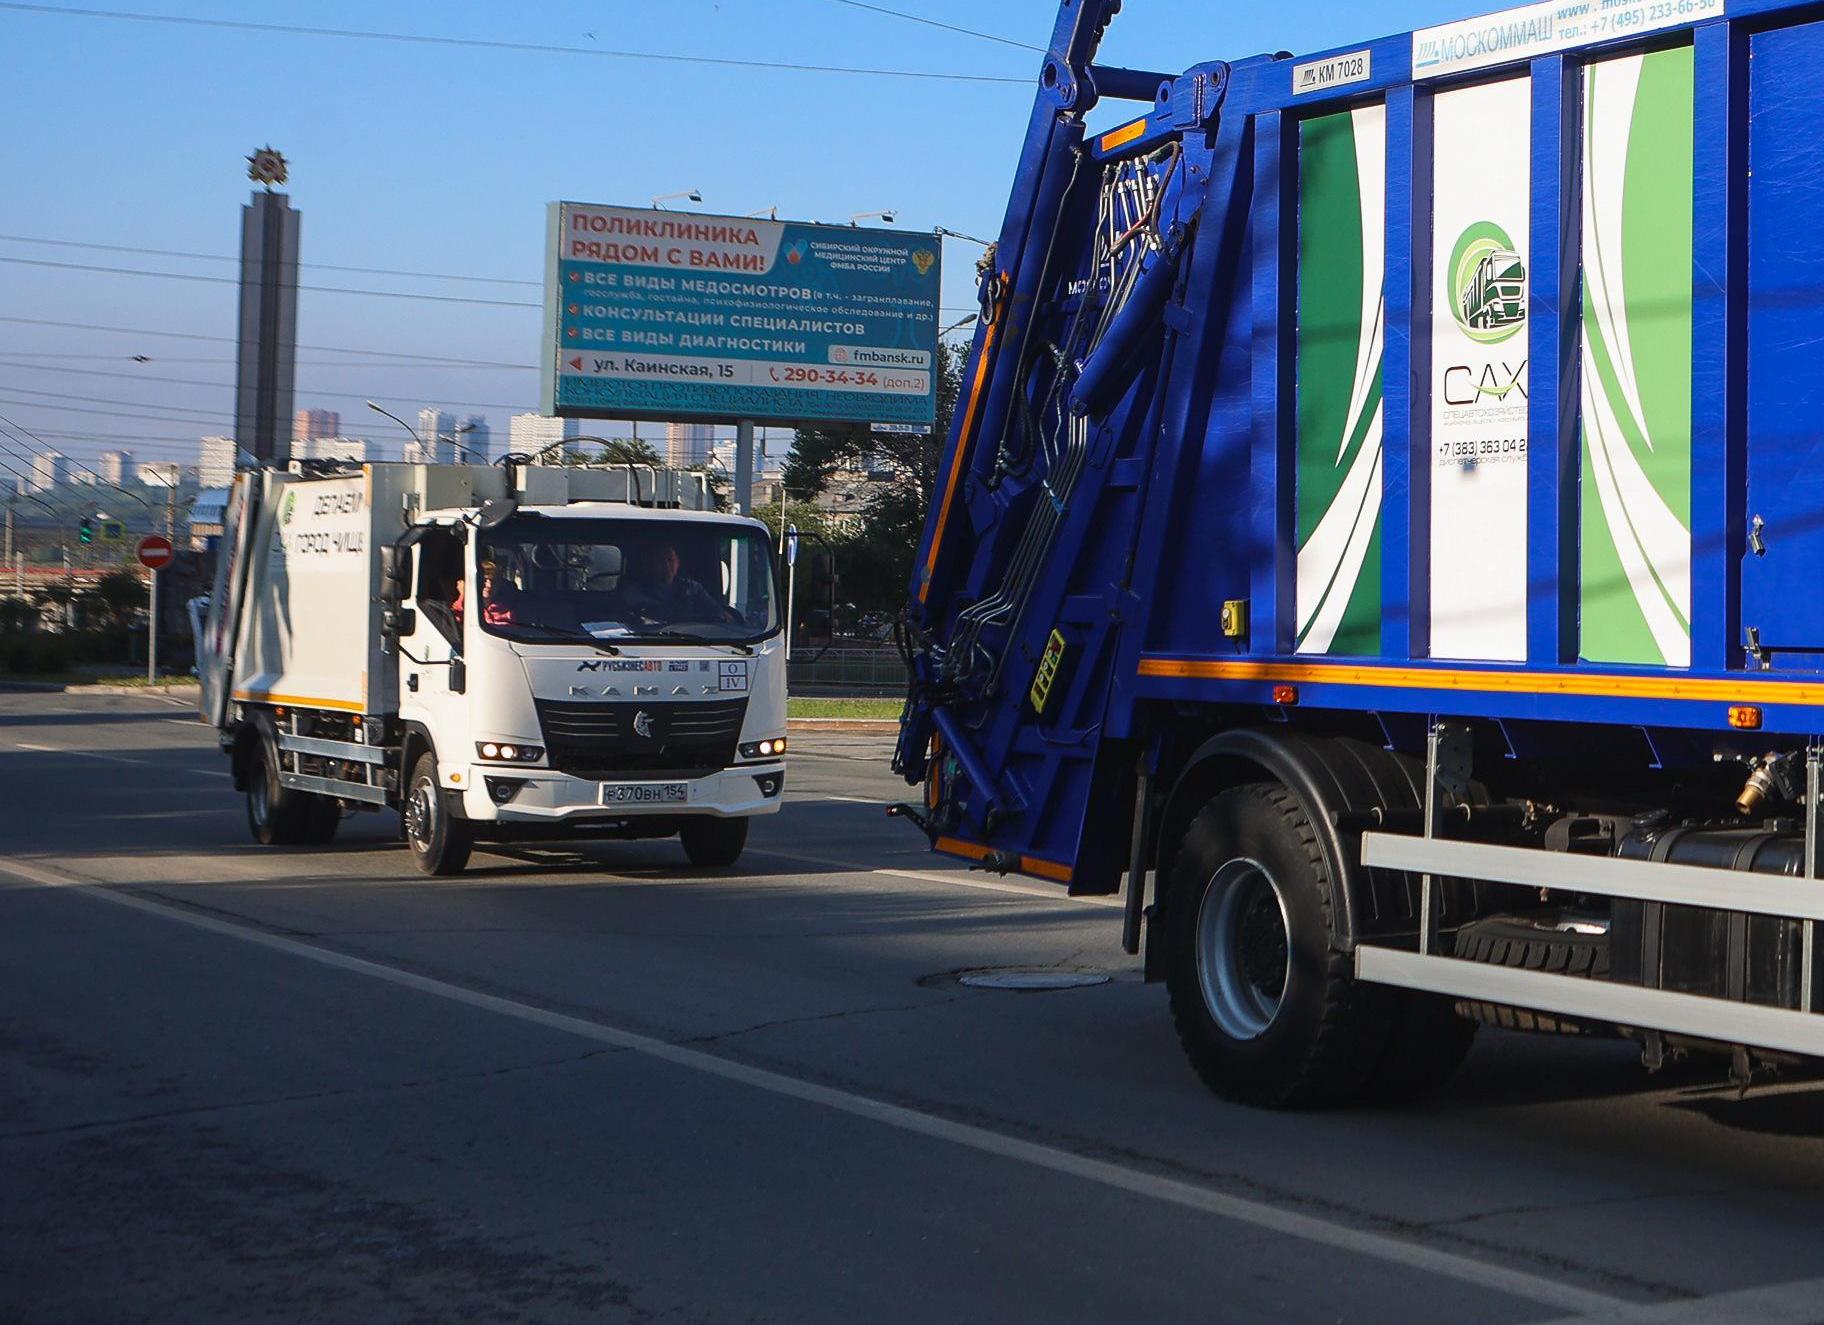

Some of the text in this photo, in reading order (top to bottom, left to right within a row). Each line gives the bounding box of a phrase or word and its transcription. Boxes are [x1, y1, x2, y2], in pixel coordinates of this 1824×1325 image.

[1591, 16, 1608, 33] +7
[1612, 8, 1645, 32] (495)
[1440, 15, 1553, 62] МОСКОММАШ
[1319, 58, 1363, 83] КМ 7028
[572, 213, 760, 245] ПОЛИКЛИНИКА
[572, 240, 765, 271] РЯДОМ С ВАМИ!
[810, 241, 909, 256] СИБИРСКИЙ ОКРУЖНОЙ
[814, 251, 906, 265] МЕДИЦИНСКИЙ ЦЕНТР
[830, 261, 891, 272] ФМБА РОССИИ
[584, 272, 811, 300] ВСЕ ВИДЫ МЕДОСМОТРОВ
[583, 305, 865, 335] КОНСУЛЬТАЦИИ СПЕЦИАЛИСТОВ
[831, 307, 904, 318] обследование
[582, 327, 806, 353] ВСЕ ВИДЫ ДИАГНОСТИКИ
[593, 358, 734, 378] ул. Каинская, 15
[854, 350, 924, 365] fmbansk.ru
[784, 367, 926, 391] 290-34-34 (доп.2)
[1444, 360, 1529, 405] САХ
[1452, 441, 1478, 456] (383)
[1480, 440, 1500, 454] 363
[1503, 439, 1516, 453] 04
[313, 492, 363, 516] ДЕЛАЕМ
[726, 678, 740, 689] IV
[664, 785, 684, 796] 154
